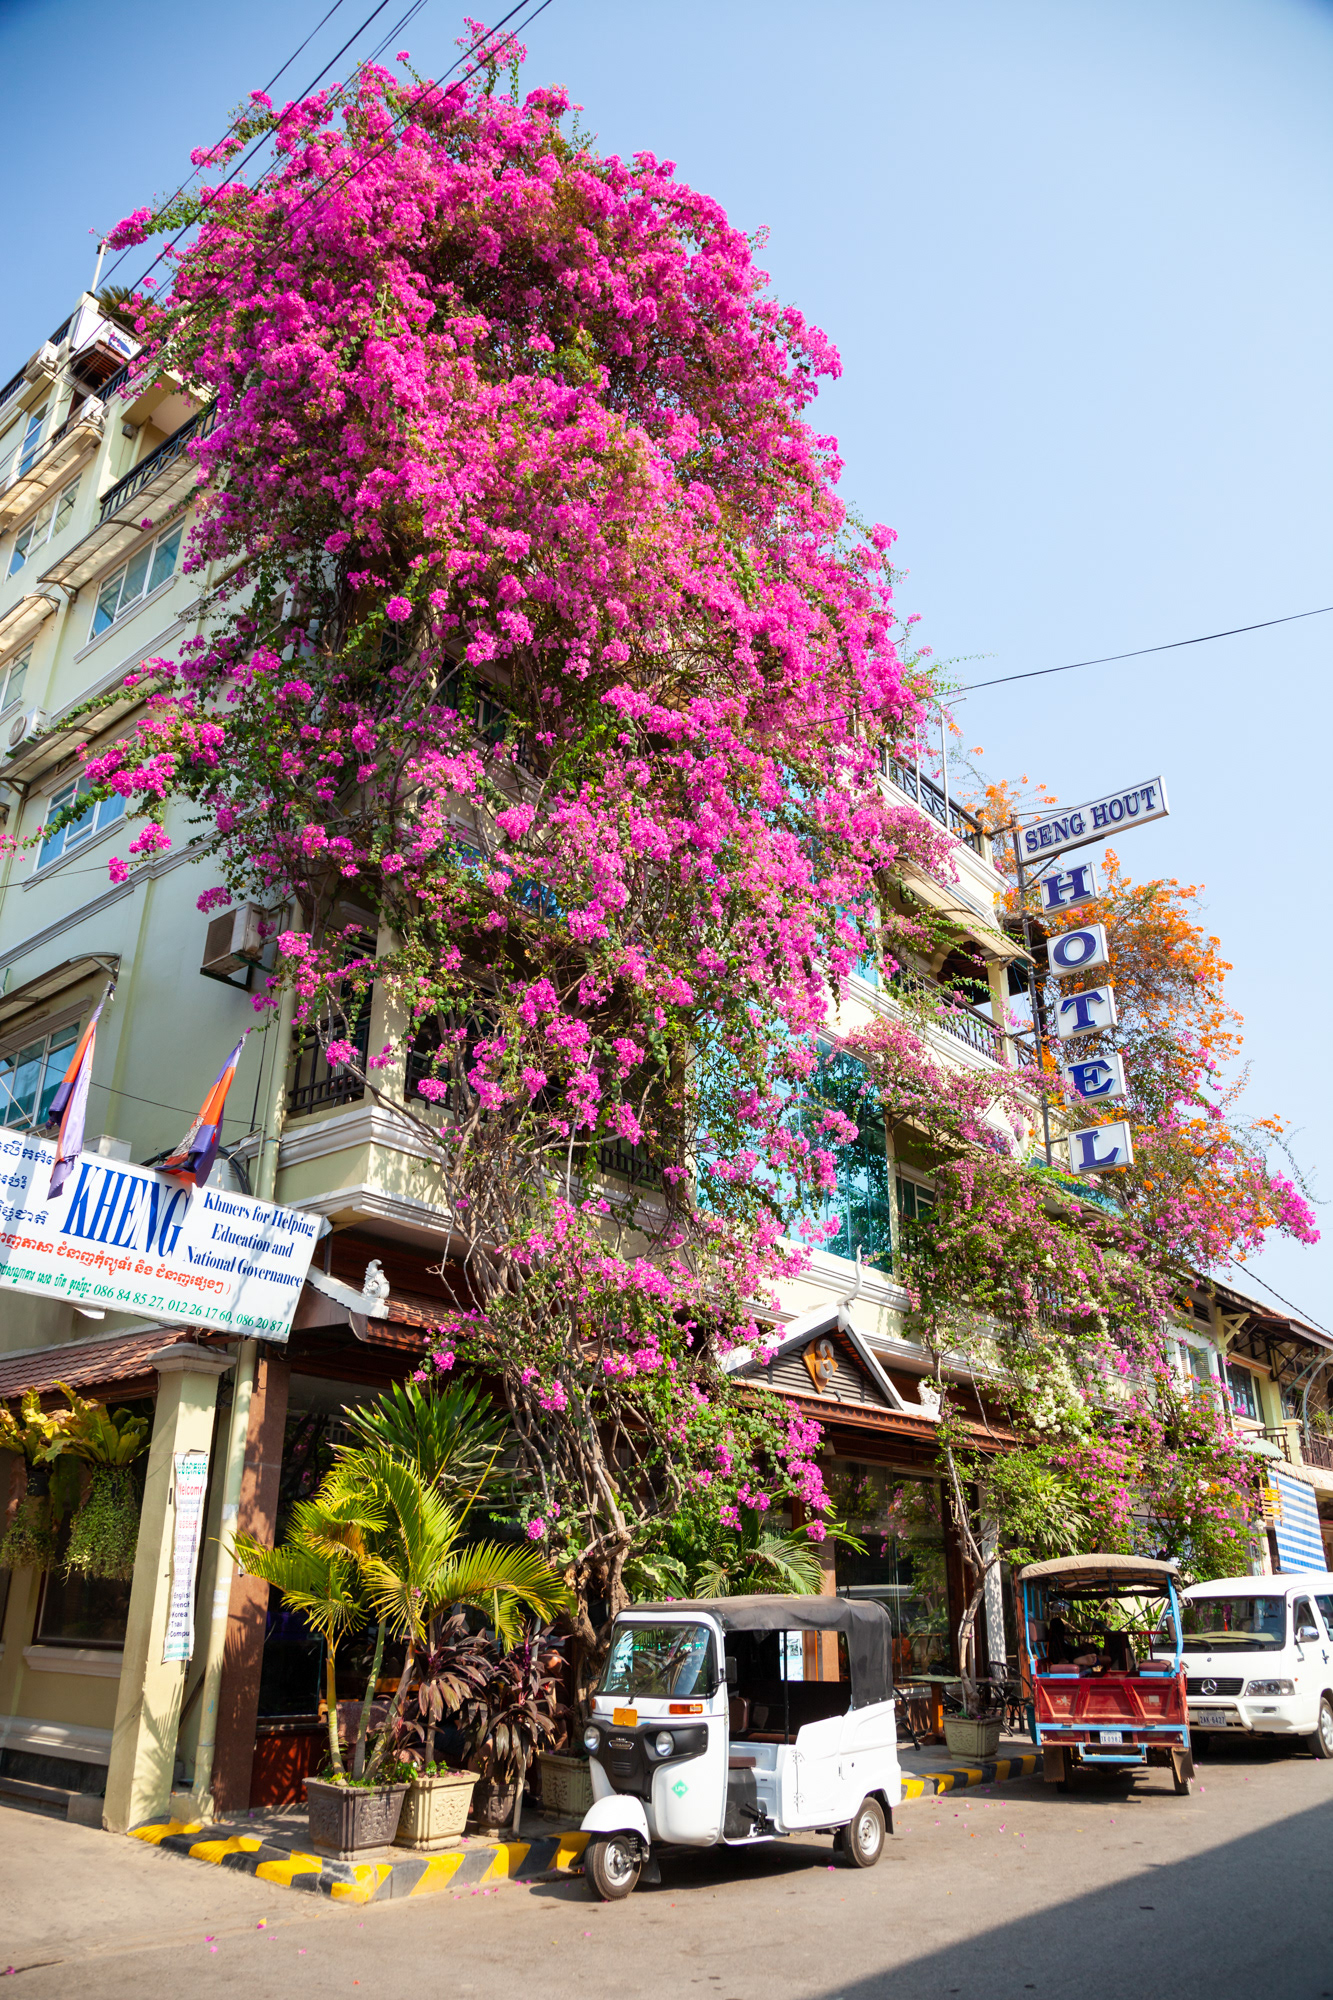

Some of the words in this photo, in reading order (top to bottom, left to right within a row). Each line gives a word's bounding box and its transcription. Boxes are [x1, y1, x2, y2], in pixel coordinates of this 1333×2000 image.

[1025, 812, 1086, 852] SENG
[1091, 785, 1156, 829] HOUT
[1042, 865, 1122, 1170] HOTEL
[59, 1162, 193, 1258] KHENG
[203, 1192, 250, 1219] Khmers
[252, 1205, 270, 1224] for
[271, 1209, 316, 1240] Helping
[211, 1223, 271, 1253] Education
[271, 1242, 295, 1258] and
[183, 1245, 237, 1273] National
[237, 1258, 303, 1288] Governance
[93, 1283, 115, 1299] 086
[116, 1288, 131, 1302] 84
[133, 1291, 148, 1305] 85
[148, 1295, 164, 1310] 27,
[167, 1299, 187, 1313] 012
[188, 1303, 202, 1317] 26
[204, 1307, 218, 1319] 17
[219, 1309, 233, 1325] 60,
[236, 1313, 255, 1327] 086
[255, 1317, 269, 1330] 20
[270, 1320, 283, 1332] 87
